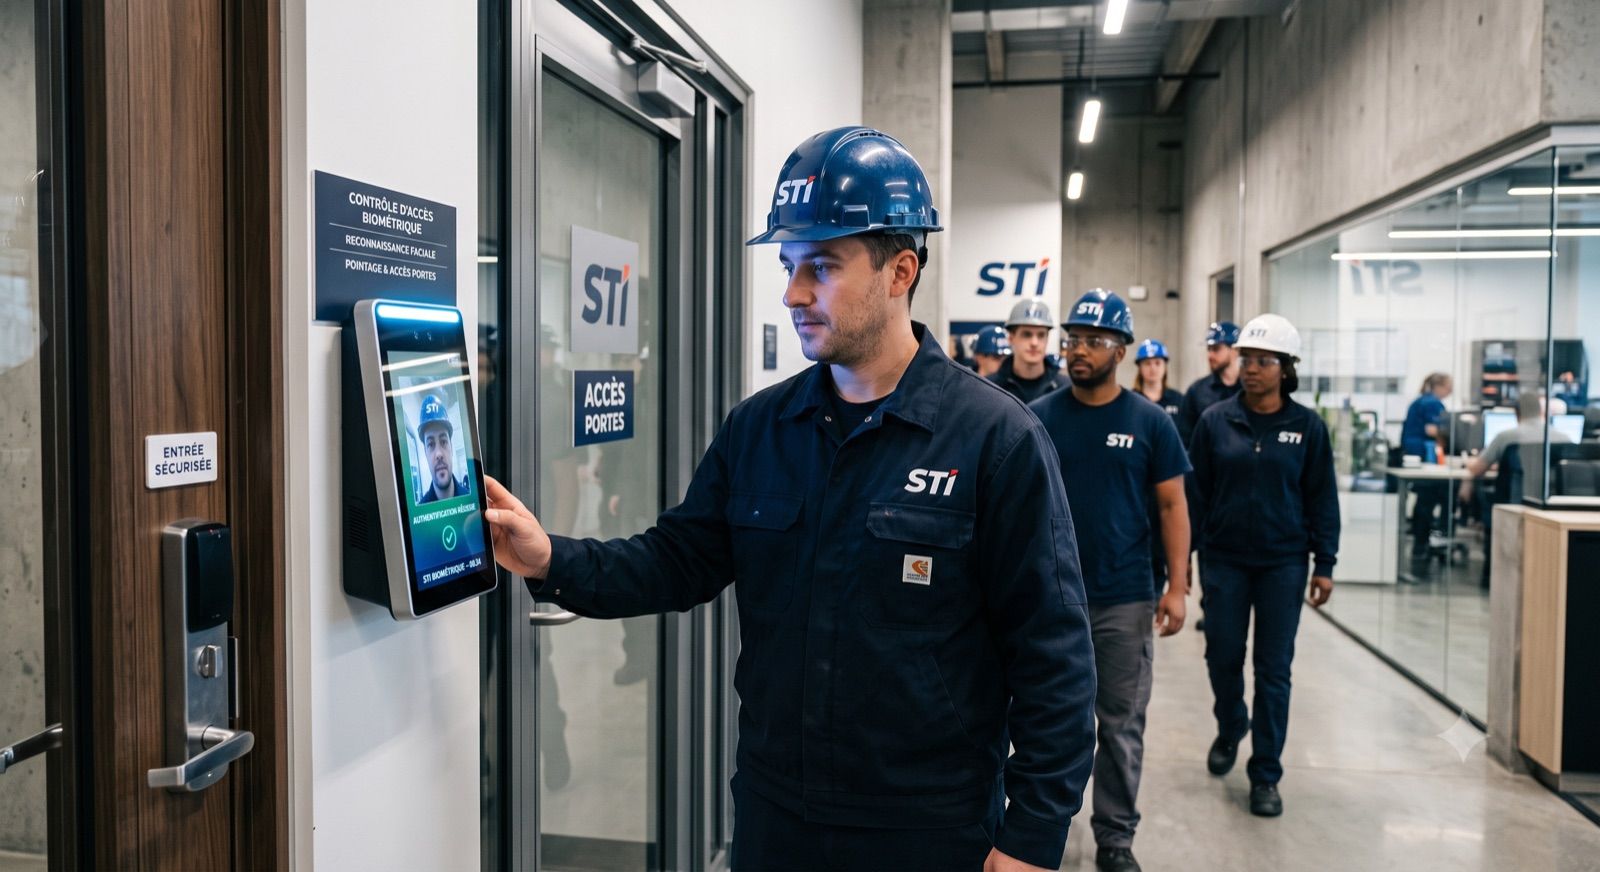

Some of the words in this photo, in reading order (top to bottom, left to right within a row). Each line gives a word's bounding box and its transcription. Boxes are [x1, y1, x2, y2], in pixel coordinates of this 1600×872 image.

[348, 192, 398, 214] CONTRÔLE
[400, 203, 434, 222] D'ACCÈS
[362, 212, 422, 235] BIOMÉTRIQUE
[345, 235, 409, 255] RECONNAISSANCE
[410, 246, 436, 259] FACIALE
[345, 259, 382, 274] POINTAGE
[383, 265, 389, 274] &
[389, 265, 411, 278] ACCÈS
[412, 269, 437, 281] PORTES
[584, 376, 626, 408] ACCÈS
[585, 411, 625, 435] PORTES
[163, 442, 204, 459] ENTRÉE
[155, 457, 212, 476] SÉCURISÉE
[413, 507, 457, 525] AUTHENTIFICATION
[422, 573, 431, 584] STI
[432, 562, 466, 580] BIOMÉTRIQUE
